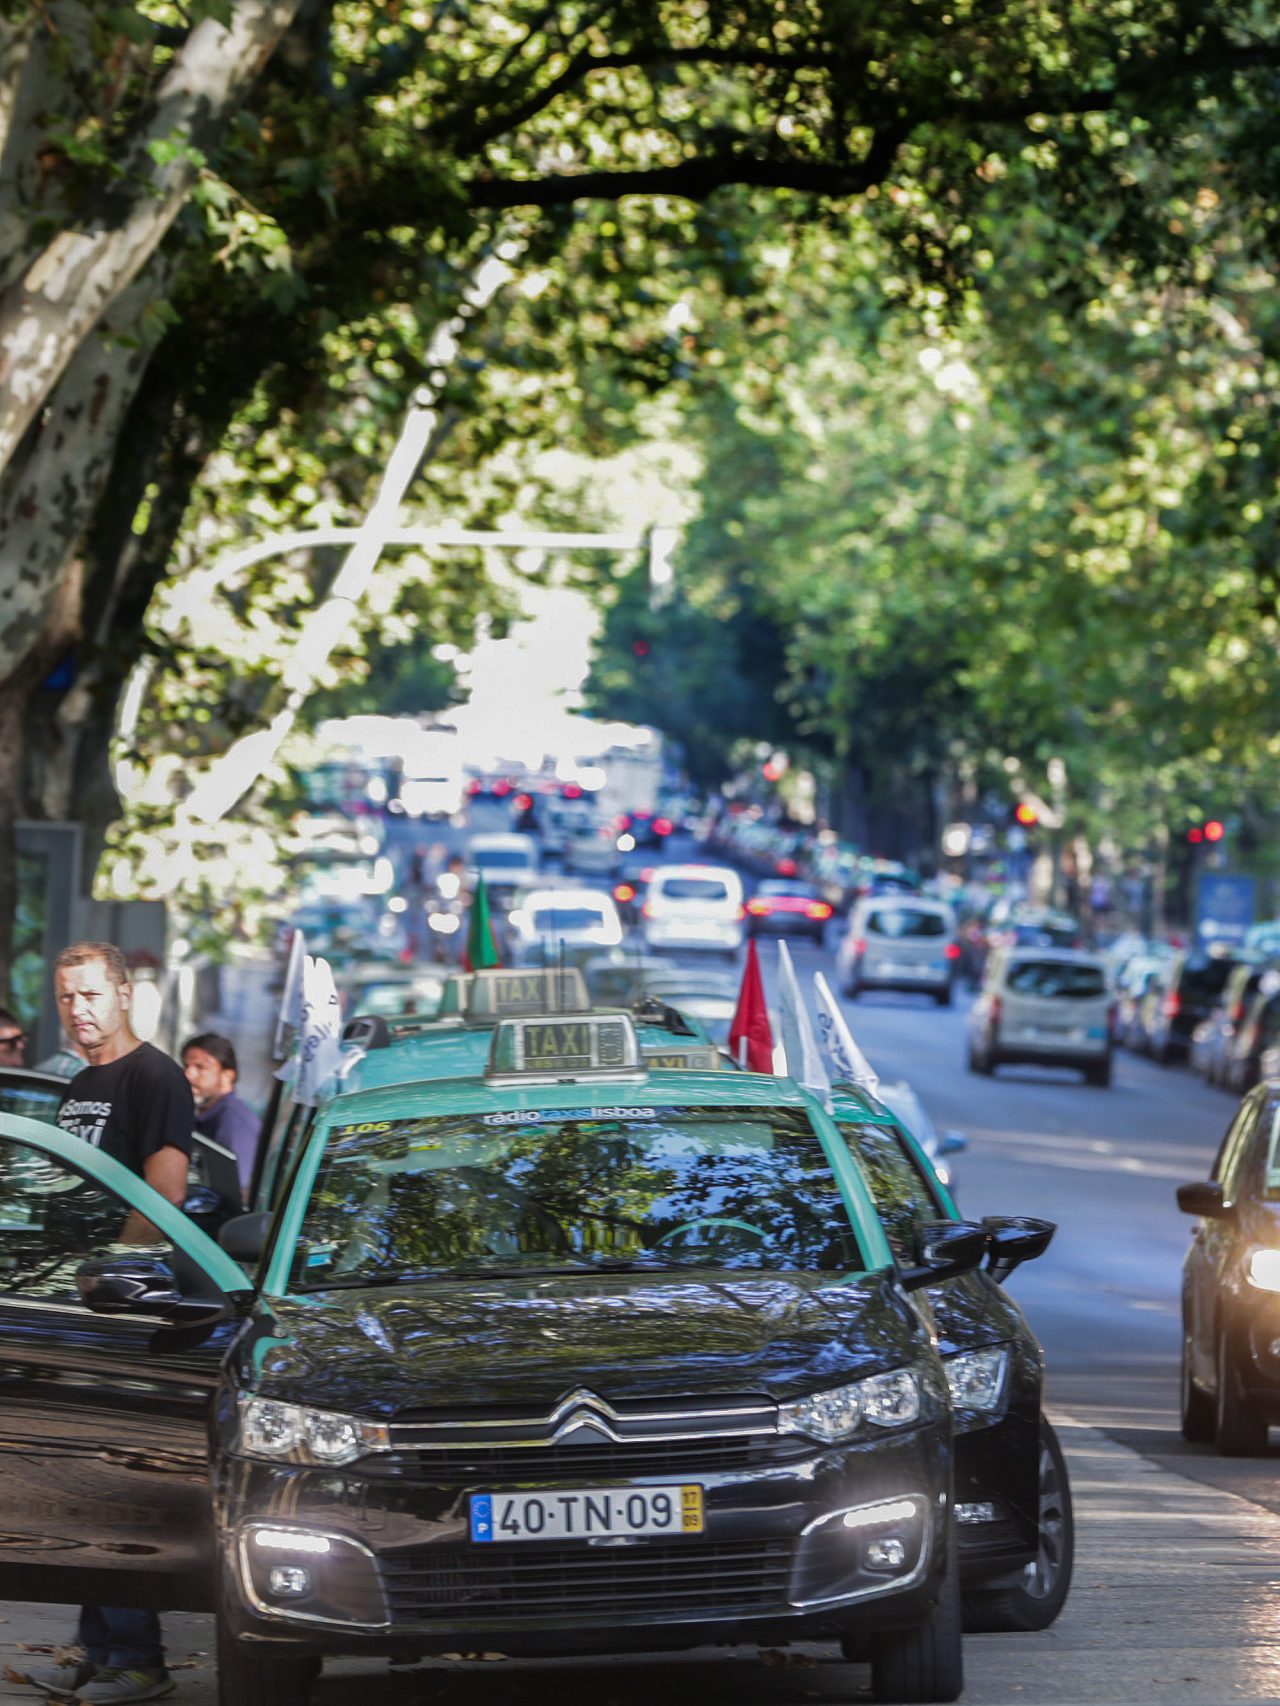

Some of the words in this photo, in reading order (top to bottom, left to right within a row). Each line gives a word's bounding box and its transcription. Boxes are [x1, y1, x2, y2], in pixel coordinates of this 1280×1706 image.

[496, 977, 544, 1000] TAX
[526, 1024, 590, 1057] TAXI
[343, 1121, 392, 1135] 106
